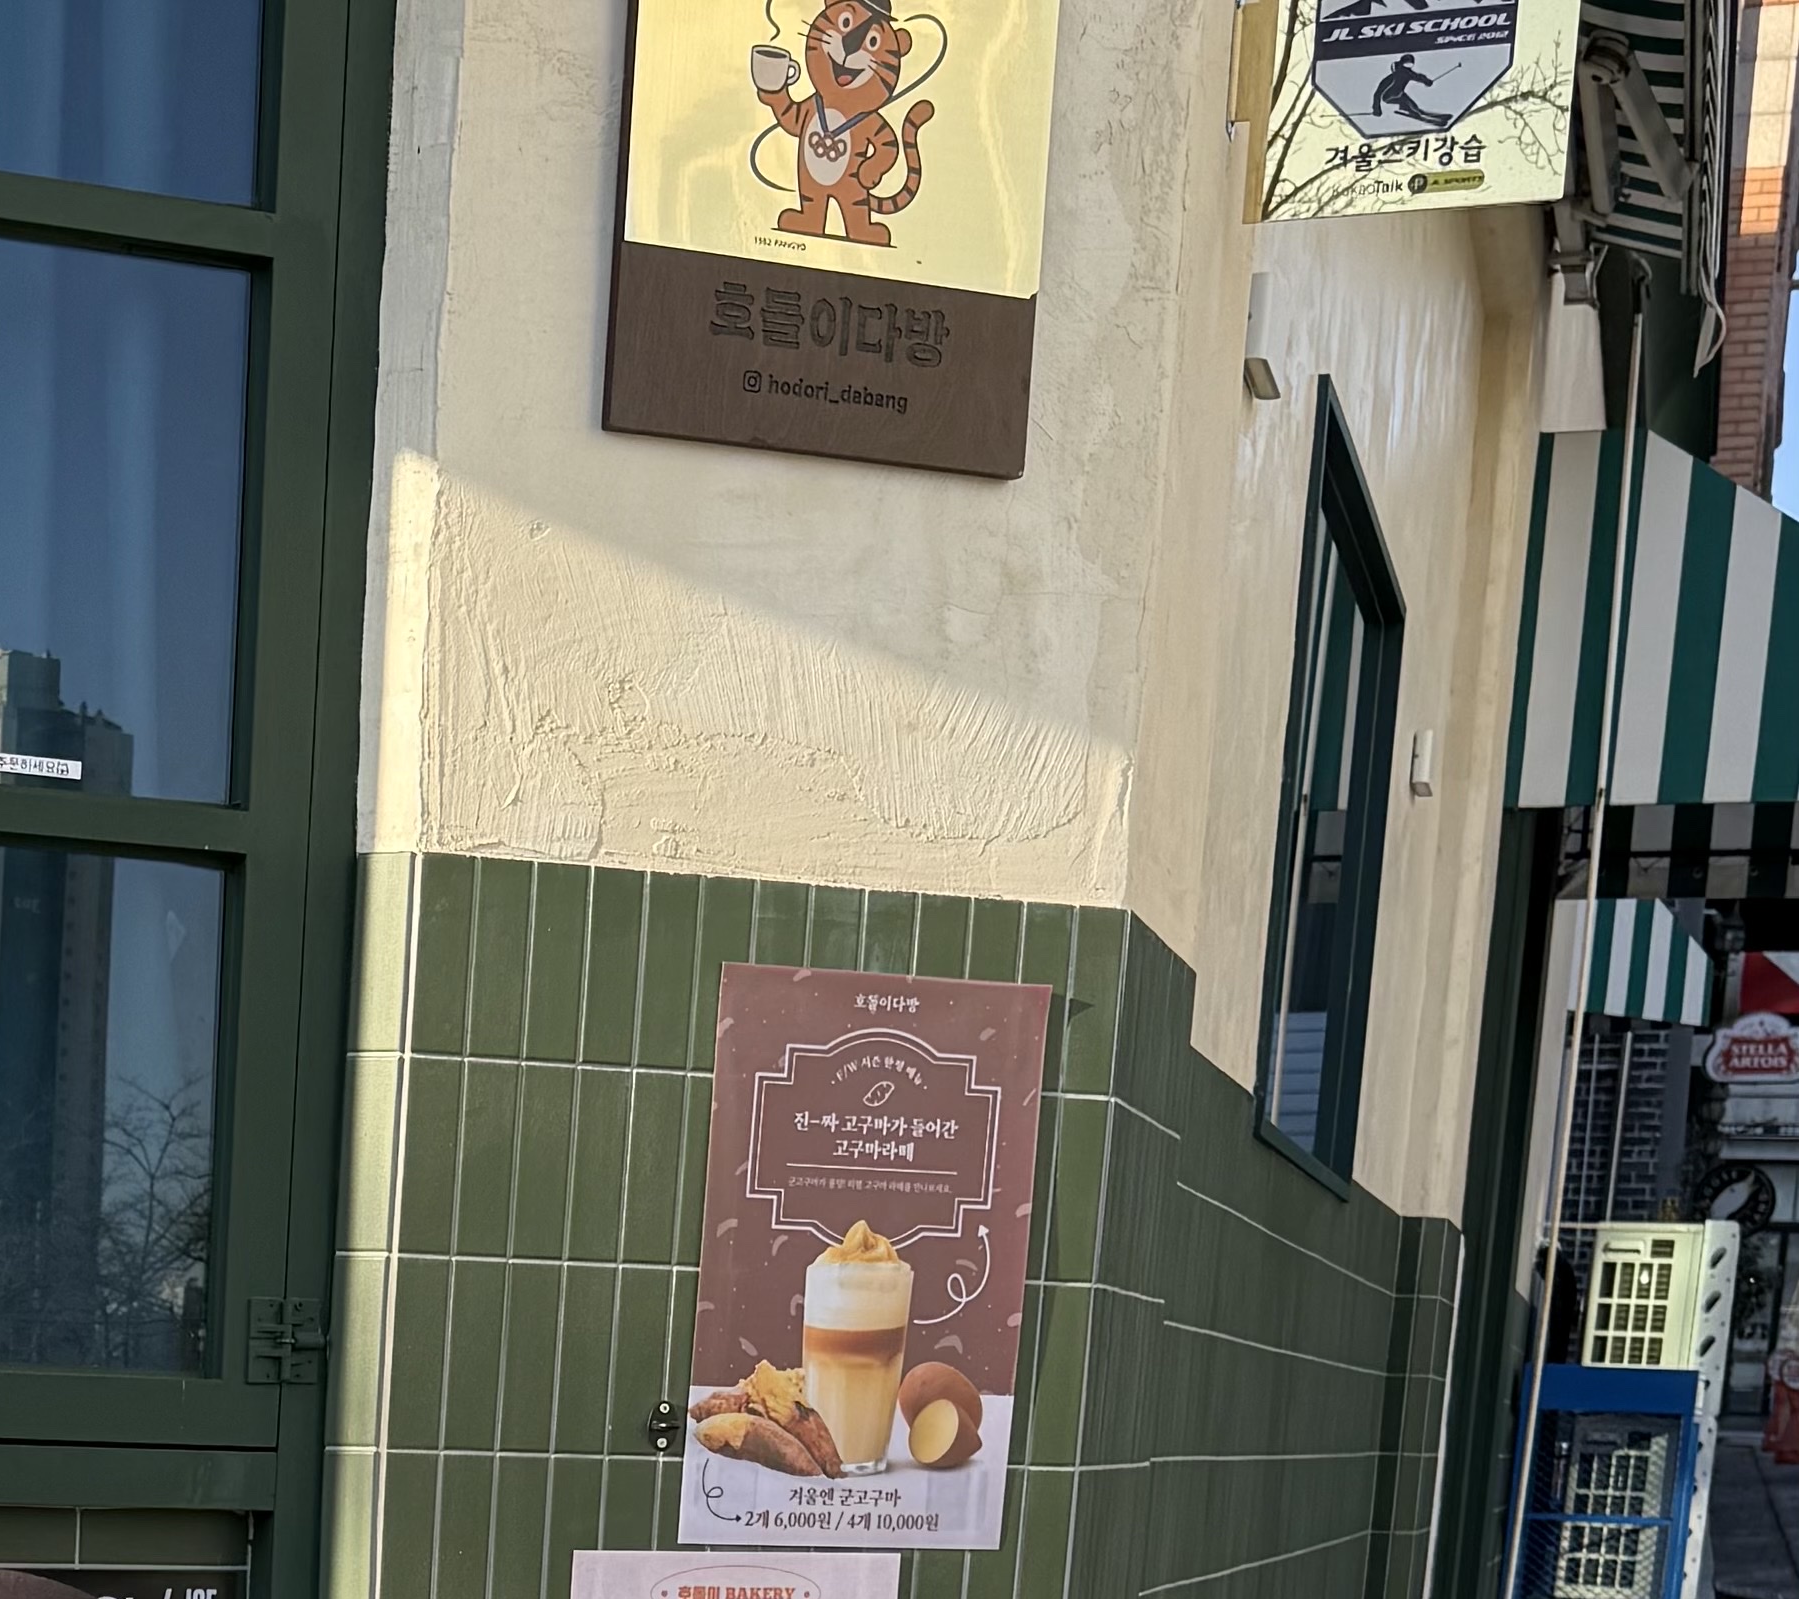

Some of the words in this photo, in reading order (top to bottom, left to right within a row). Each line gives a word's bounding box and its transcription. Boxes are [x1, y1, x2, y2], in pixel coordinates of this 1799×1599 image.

[1358, 22, 1405, 39] SKI
[1406, 12, 1512, 35] SCHOOL
[767, 373, 909, 415] hodori_dabang
[1731, 1042, 1788, 1055] STELLA
[1729, 1056, 1788, 1068] ARTOIS
[841, 1115, 908, 1136] 고구마가
[910, 1118, 959, 1139] 들어간
[839, 1488, 902, 1507] 군고구마
[744, 1509, 770, 1529] 2개
[774, 1511, 832, 1530] 6,000원
[847, 1512, 872, 1531] 4개
[876, 1513, 940, 1532] 10,000원
